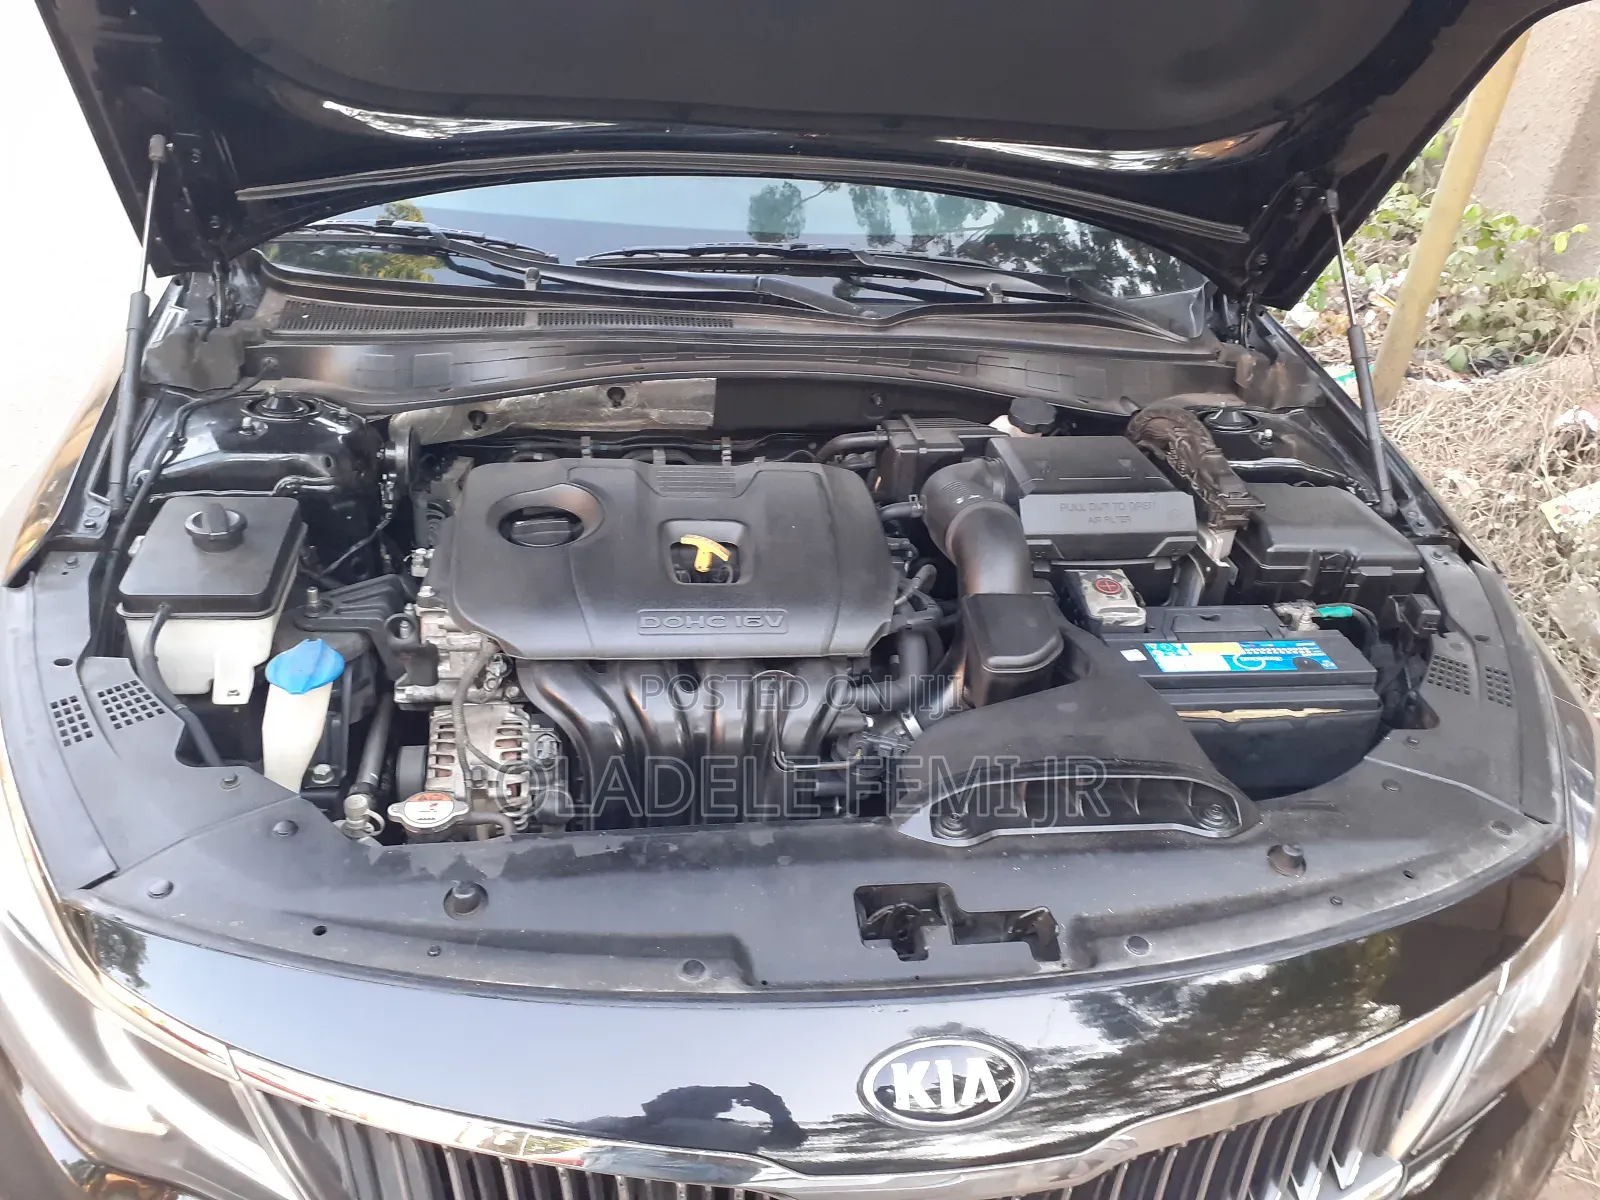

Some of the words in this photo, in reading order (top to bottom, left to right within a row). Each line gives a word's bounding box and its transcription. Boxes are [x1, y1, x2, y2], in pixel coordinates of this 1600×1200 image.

[1060, 502, 1087, 512] PULL
[1089, 502, 1110, 511] OUT
[1111, 501, 1125, 511] TO
[1129, 501, 1156, 511] OPEN
[1088, 515, 1102, 524] AIR
[1104, 515, 1132, 524] FILTER
[639, 615, 727, 629] DOHC
[735, 615, 784, 628] 16V
[890, 1057, 1002, 1110] KIA
